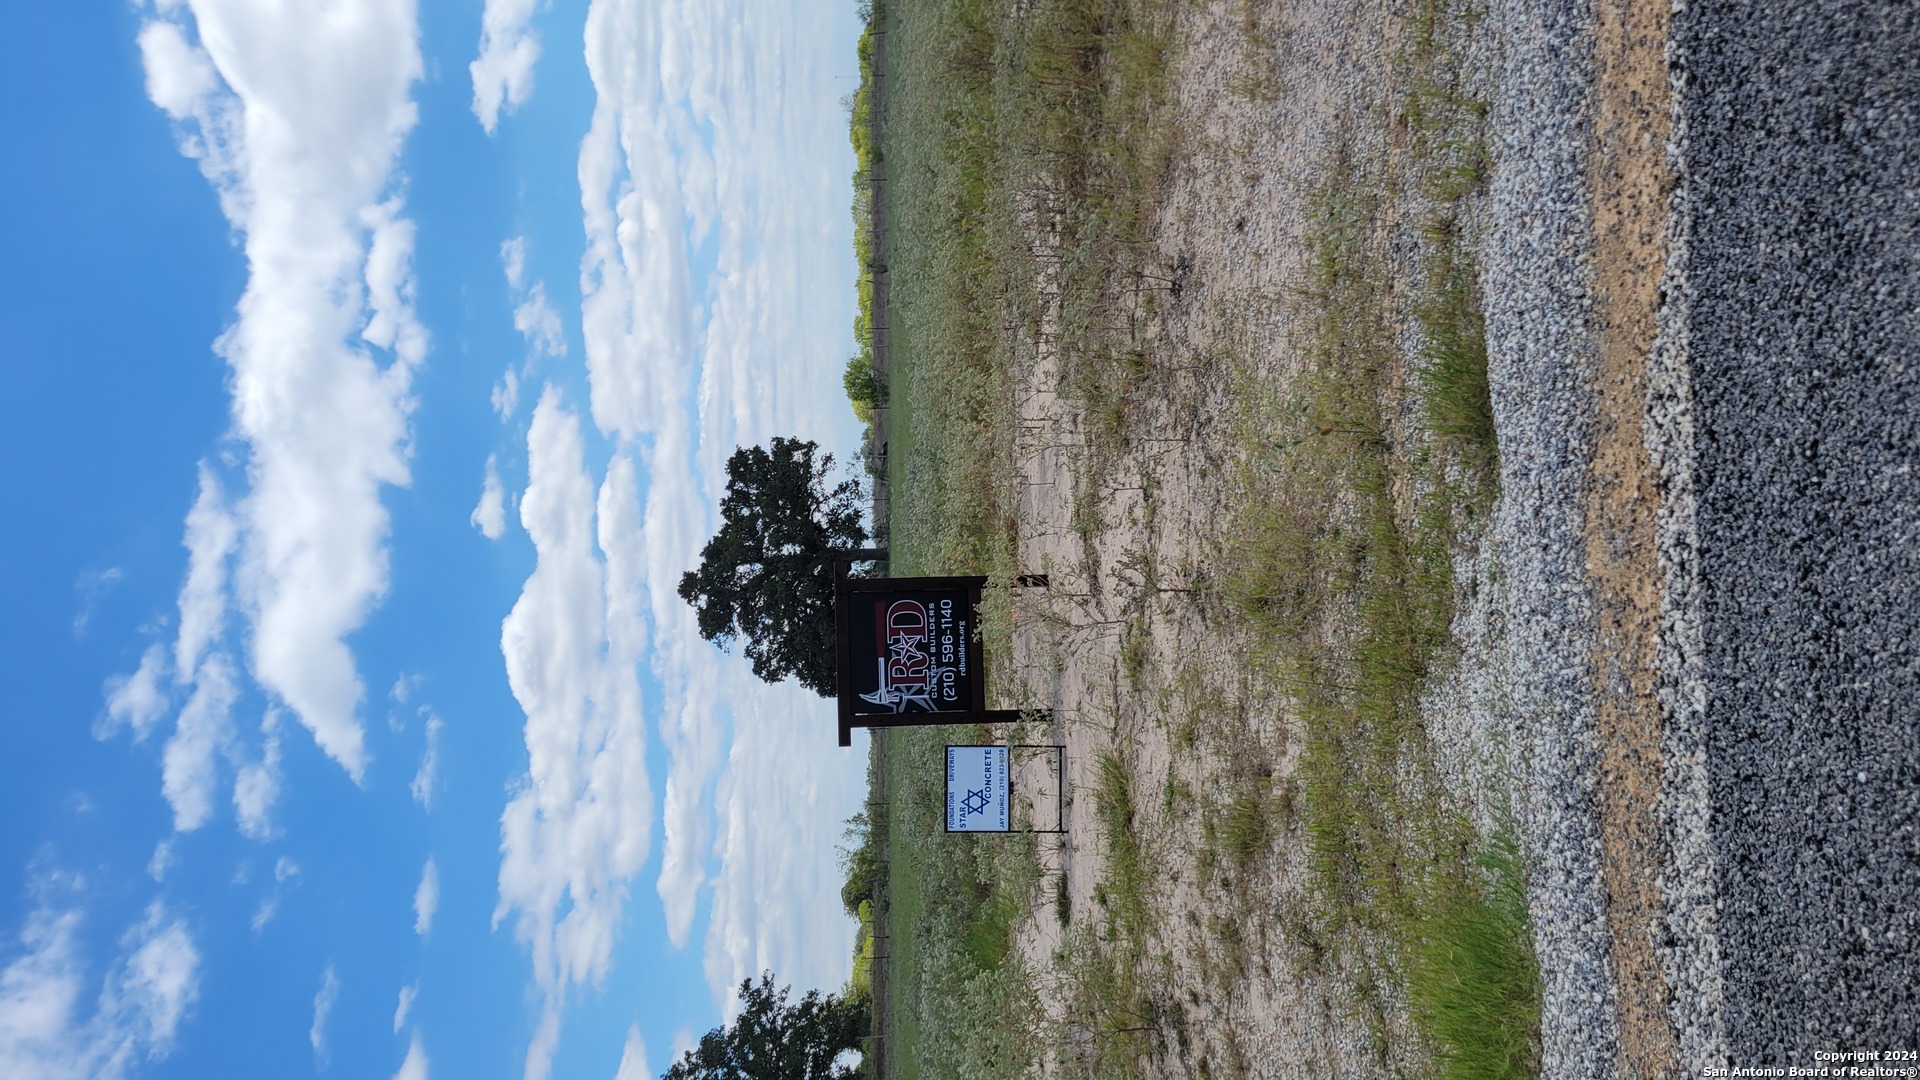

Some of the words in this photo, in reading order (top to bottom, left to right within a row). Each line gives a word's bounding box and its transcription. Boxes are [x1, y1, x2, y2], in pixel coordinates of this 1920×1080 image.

[940, 599, 954, 662] 596-1140
[958, 620, 967, 676] rdbuilders.org
[930, 656, 938, 698] CUSTOM
[942, 667, 958, 701] (210)
[984, 749, 992, 799] CONCRETE
[959, 806, 967, 828] STAR
